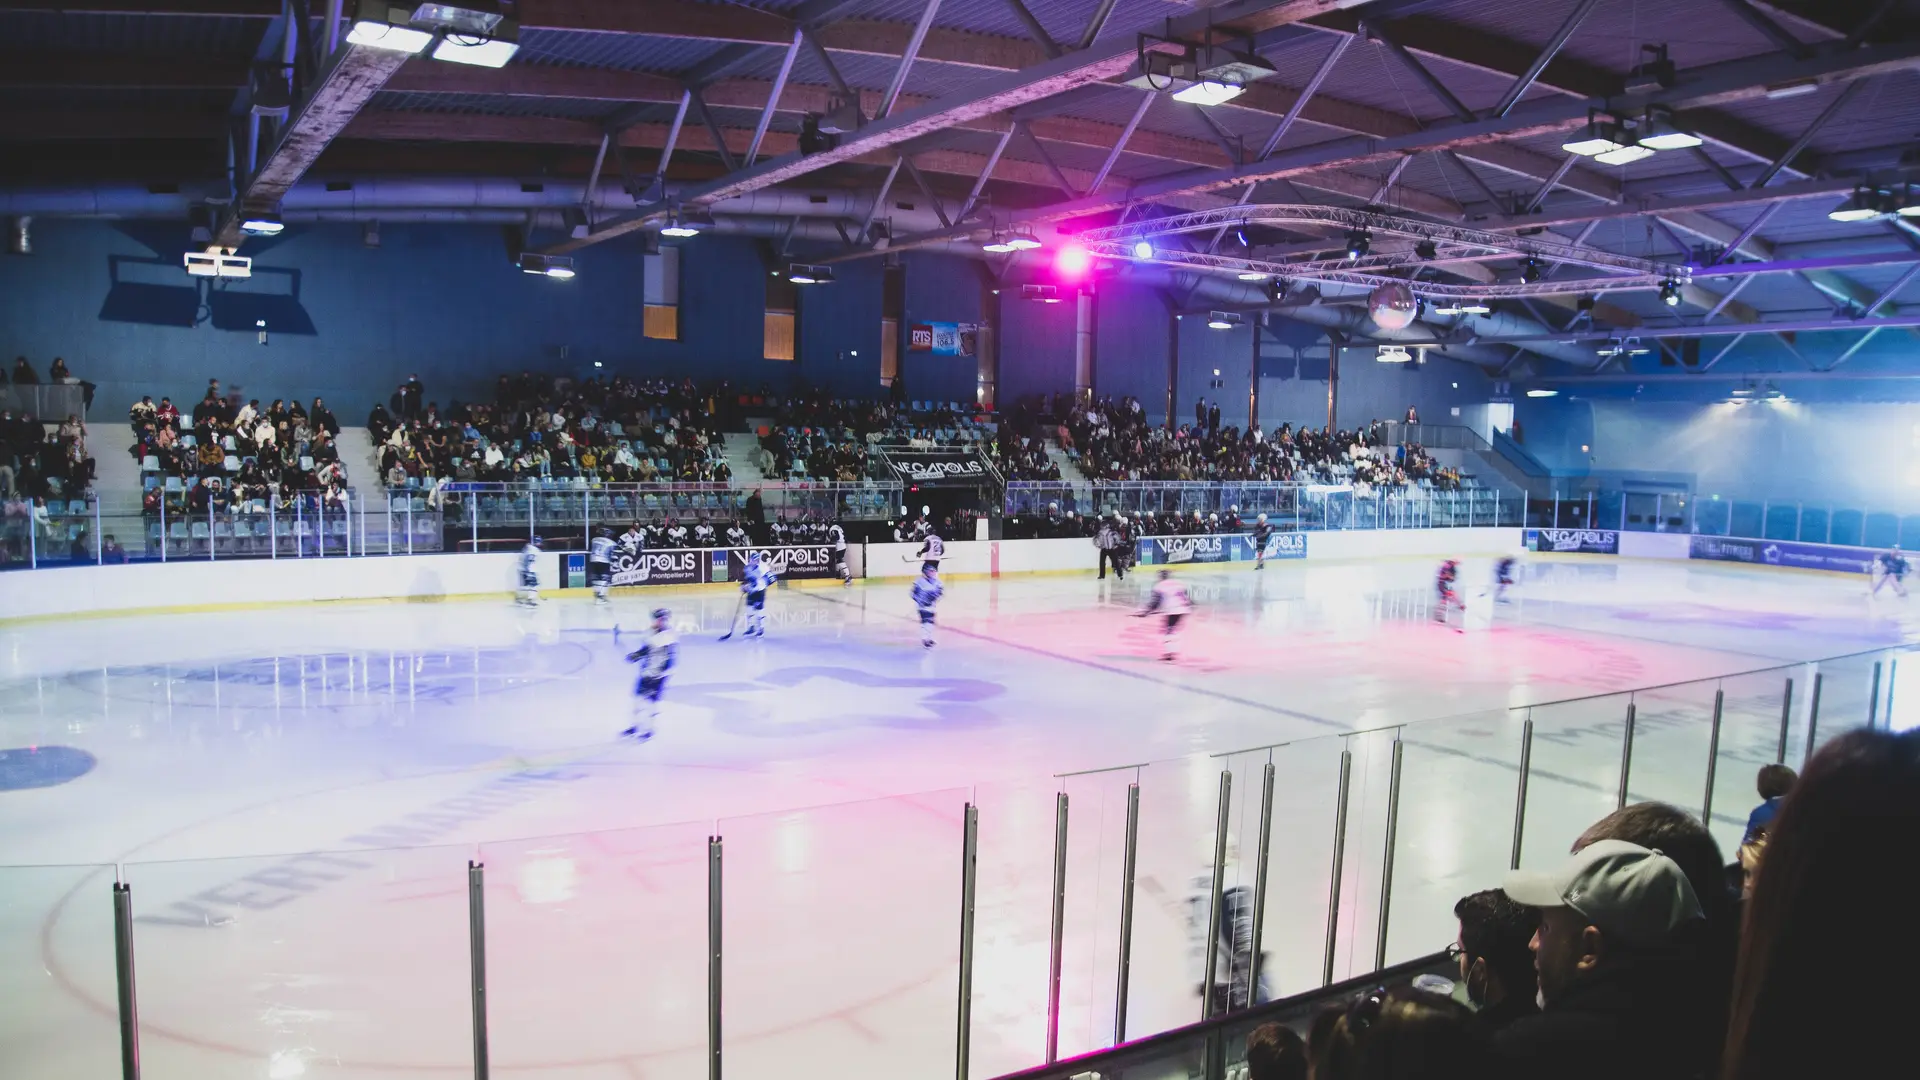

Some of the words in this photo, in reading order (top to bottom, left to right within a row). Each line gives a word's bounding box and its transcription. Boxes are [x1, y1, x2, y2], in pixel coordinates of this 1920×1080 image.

[912, 329, 931, 343] RTS
[1244, 534, 1304, 550] VAPOLIS
[1541, 529, 1615, 544] VEGAPOLIS
[1157, 537, 1222, 553] VEGAPOLIS
[609, 552, 696, 573] EGAPOLIS
[132, 852, 376, 928] VERT
